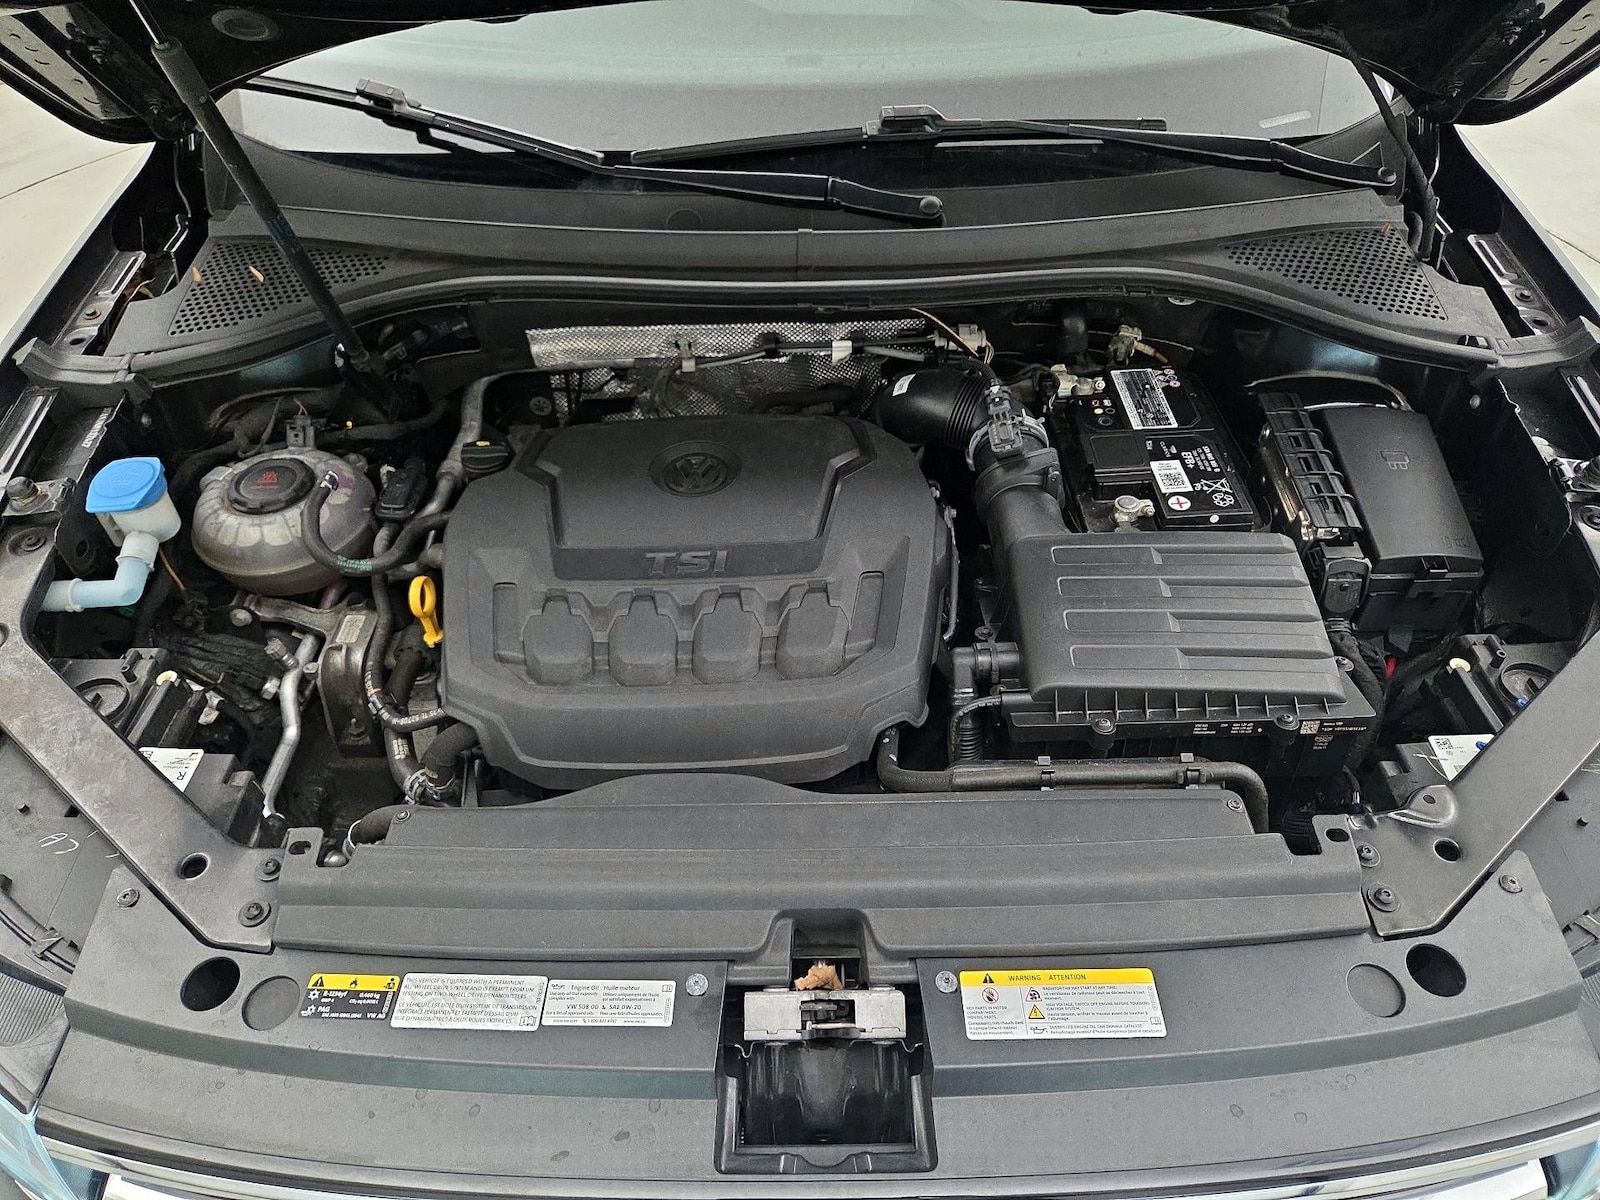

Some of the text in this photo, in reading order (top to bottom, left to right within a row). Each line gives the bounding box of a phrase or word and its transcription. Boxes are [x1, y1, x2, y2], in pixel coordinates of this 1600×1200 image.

[1181, 452, 1195, 469] EFB+
[644, 550, 729, 578] TSI
[177, 771, 187, 780] R
